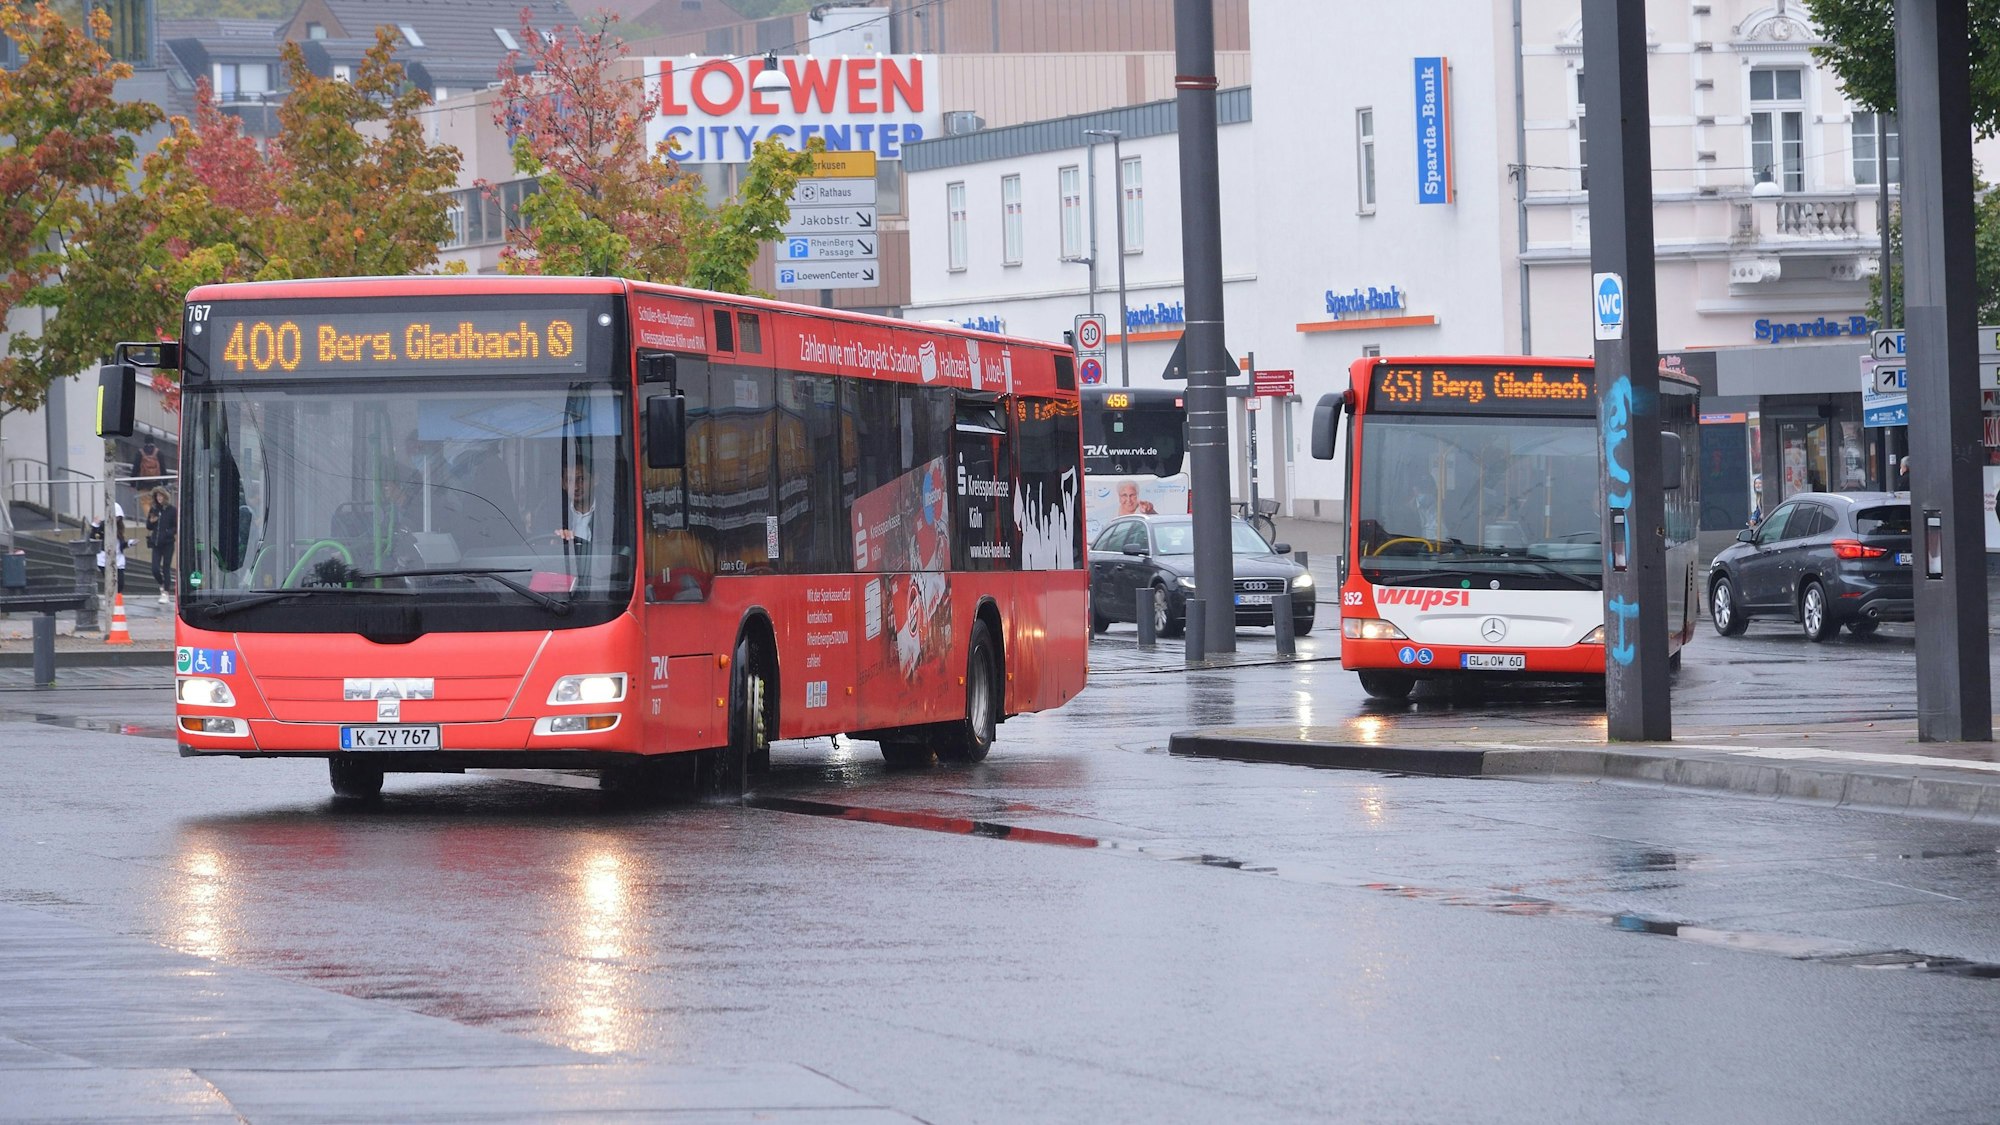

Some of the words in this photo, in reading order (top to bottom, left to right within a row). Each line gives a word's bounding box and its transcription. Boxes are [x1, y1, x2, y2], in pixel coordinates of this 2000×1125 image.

[660, 58, 924, 116] LOEWEN
[1422, 66, 1438, 196] Sparda-Bank
[820, 187, 852, 198] Rathaus
[800, 215, 853, 227] Jakobstr.
[811, 239, 854, 249] RheinBerg
[819, 248, 854, 258] Passage
[797, 271, 859, 281] LoewenCenter
[1325, 285, 1403, 320] Sparda-Bank
[1599, 293, 1620, 315] WC
[187, 304, 211, 322] 767
[637, 305, 696, 328] Schüler-Bus-Kooperation
[1083, 327, 1097, 342] 30
[1754, 314, 1880, 344] Sparda-Ba
[223, 321, 302, 372] 400
[318, 324, 397, 361] Berg.
[405, 321, 539, 360] Gladbach
[640, 328, 676, 350] Kreissparkasse
[676, 334, 686, 349] Köln
[686, 336, 695, 350] und
[695, 337, 706, 351] RVK
[798, 333, 827, 364] Zahlen
[827, 338, 842, 365] wie
[842, 341, 858, 367] mit
[858, 342, 889, 378] Bargeld:
[890, 347, 920, 374] Stadion-
[939, 356, 970, 381] Halbzeit-
[984, 358, 1005, 384] Jubel-
[1380, 370, 1423, 402] 451
[1493, 371, 1587, 400] Gladbach
[1107, 394, 1128, 409] 456
[1109, 447, 1158, 456] www.rvk.de
[968, 474, 1009, 502] Kreissparkasse
[870, 513, 901, 540] Kreissparkasse
[969, 506, 983, 529] Köln
[872, 544, 881, 562] Köln
[970, 540, 1011, 559] www.ksk-koeln.de
[735, 559, 748, 573] City
[806, 589, 814, 603] Mit
[1343, 591, 1363, 606] 352
[1377, 588, 1470, 612] wupsi
[806, 609, 828, 624] kontaktlos
[1469, 655, 1484, 668] GL
[1508, 655, 1523, 667] 60
[343, 677, 435, 700] MAN
[356, 730, 367, 746] K
[377, 729, 398, 746] ZY
[402, 729, 431, 745] 767
